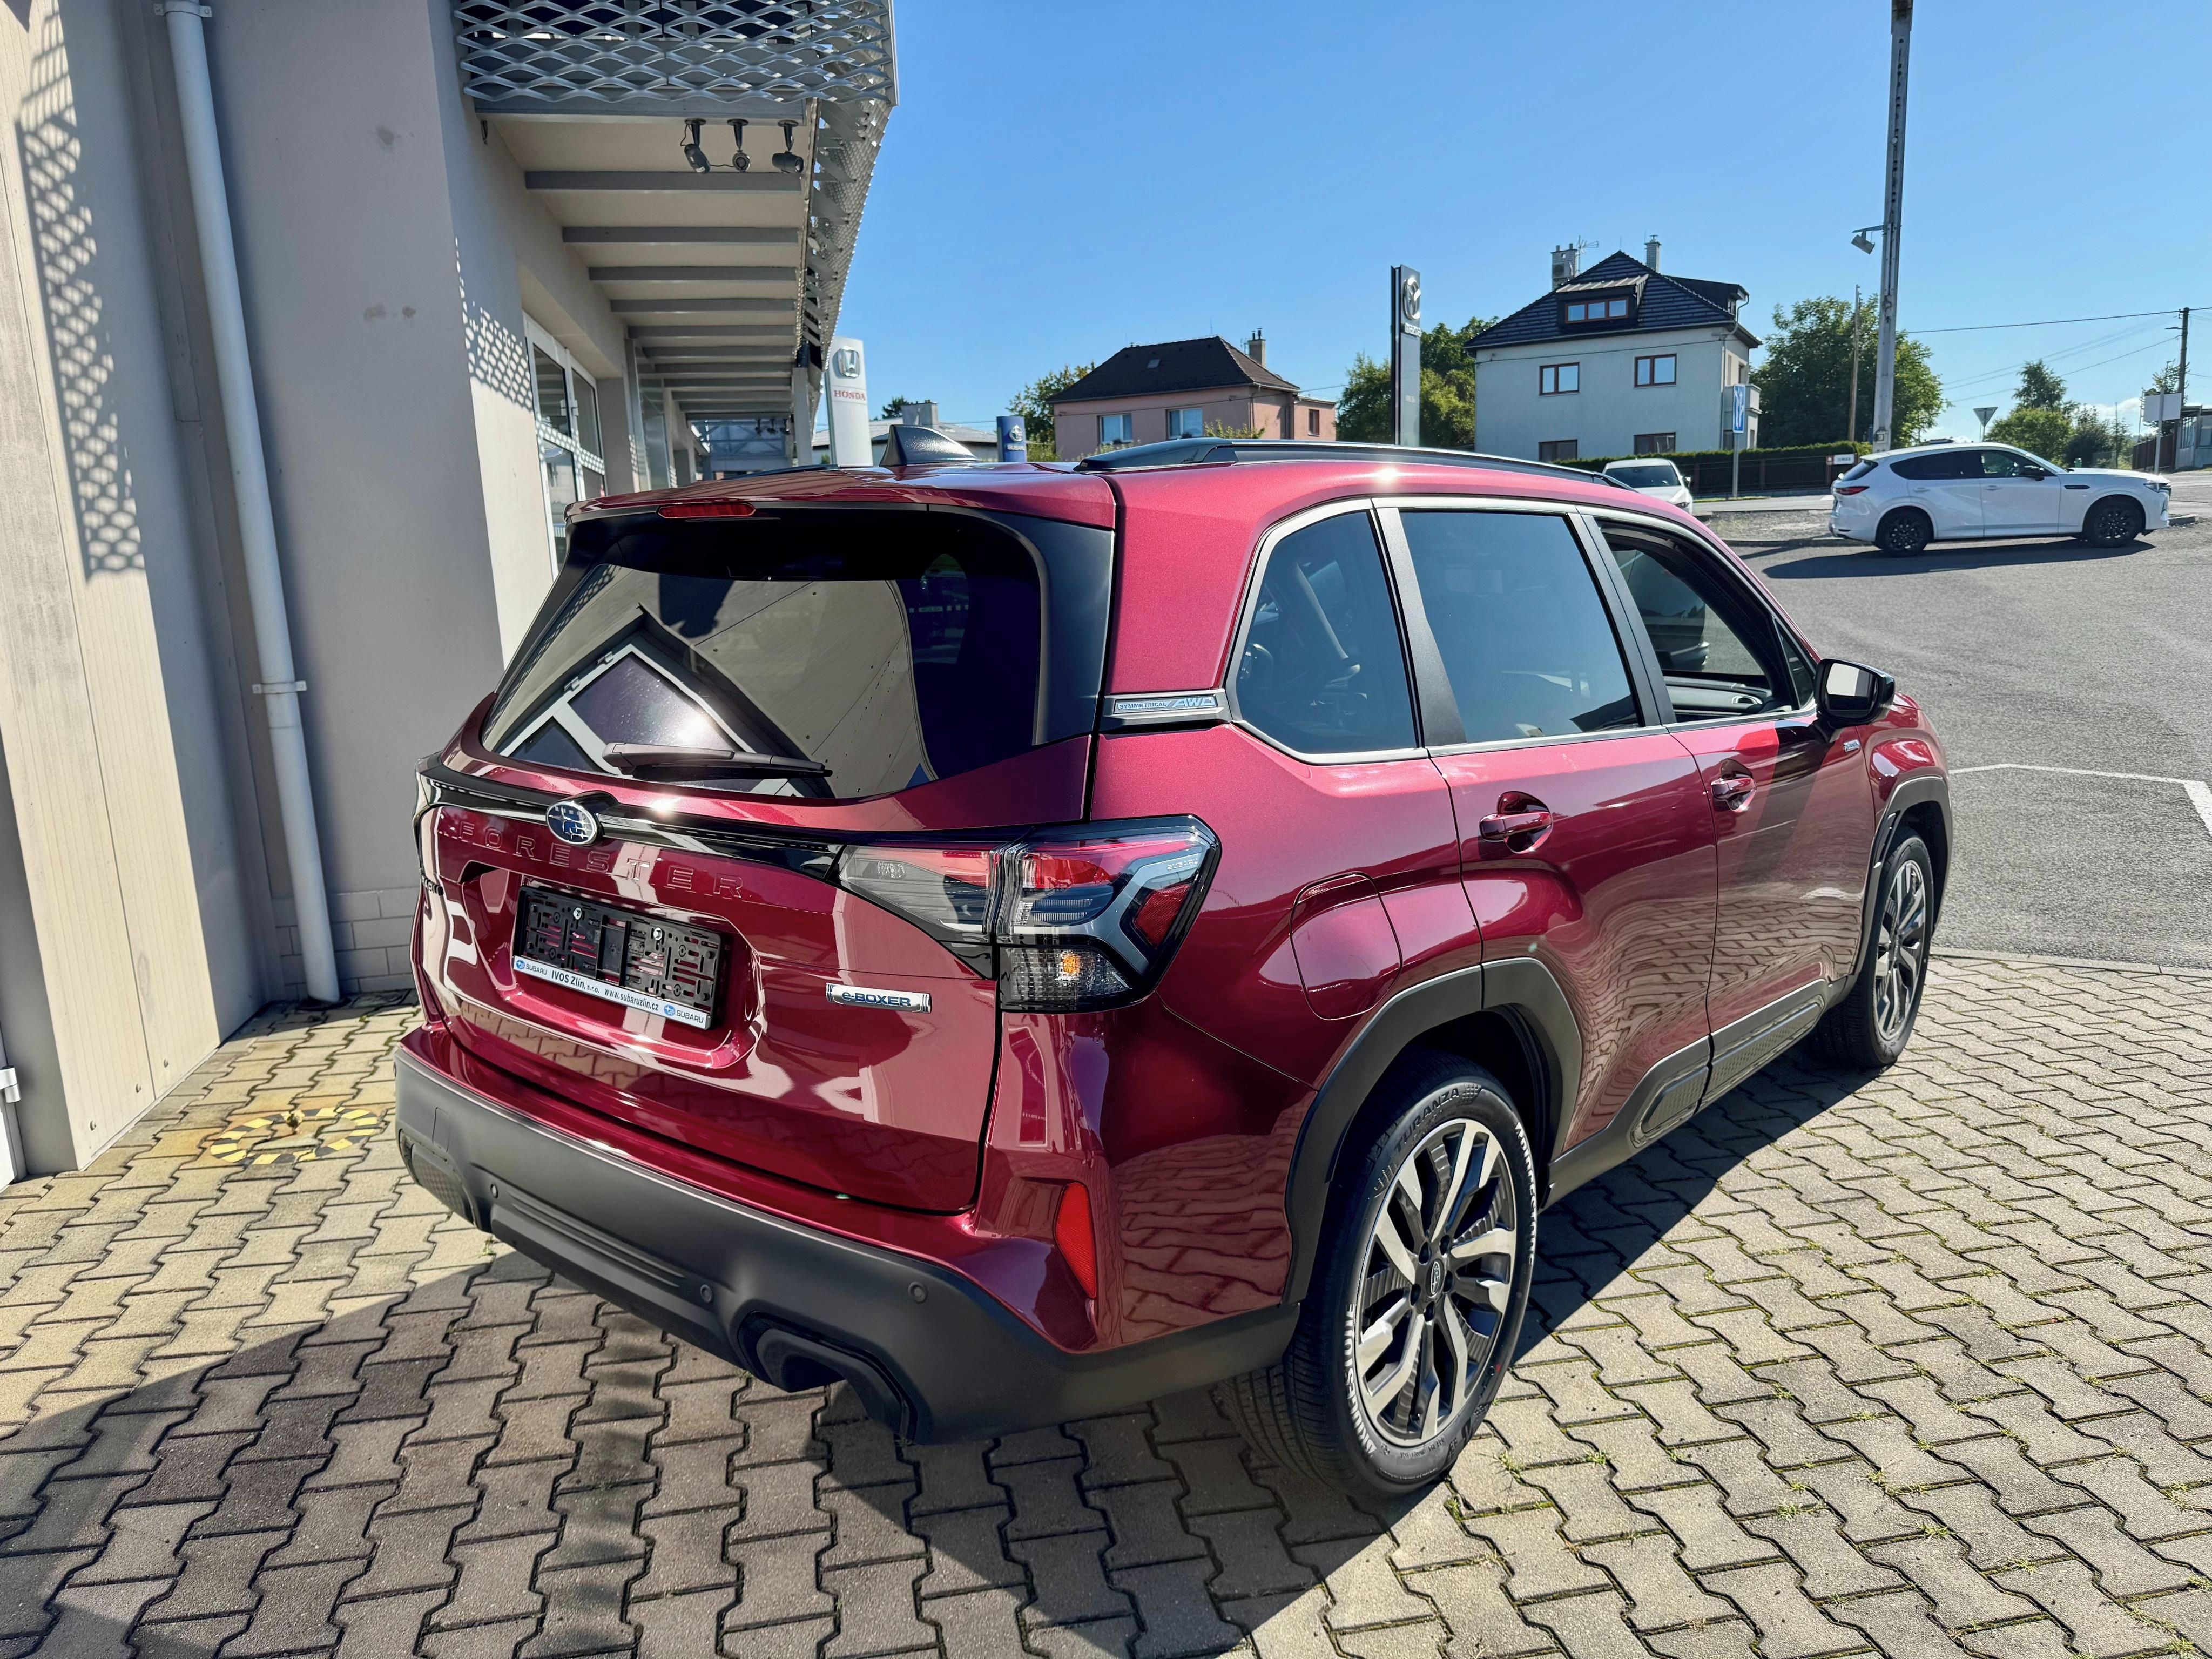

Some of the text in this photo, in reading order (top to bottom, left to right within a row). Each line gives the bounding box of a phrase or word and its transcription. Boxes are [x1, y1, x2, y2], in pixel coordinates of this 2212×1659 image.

[833, 389, 866, 401] HONDA
[1172, 697, 1215, 708] AWD
[459, 821, 744, 899] FORESTER
[1166, 858, 1198, 871] SUBARU
[526, 963, 704, 1023] SUBARU IVOS Zlín, s.r.o. www.subaruzlin.cz SUBARU
[841, 992, 912, 1008] e-BOXER
[1394, 1088, 1459, 1153] TURANZA
